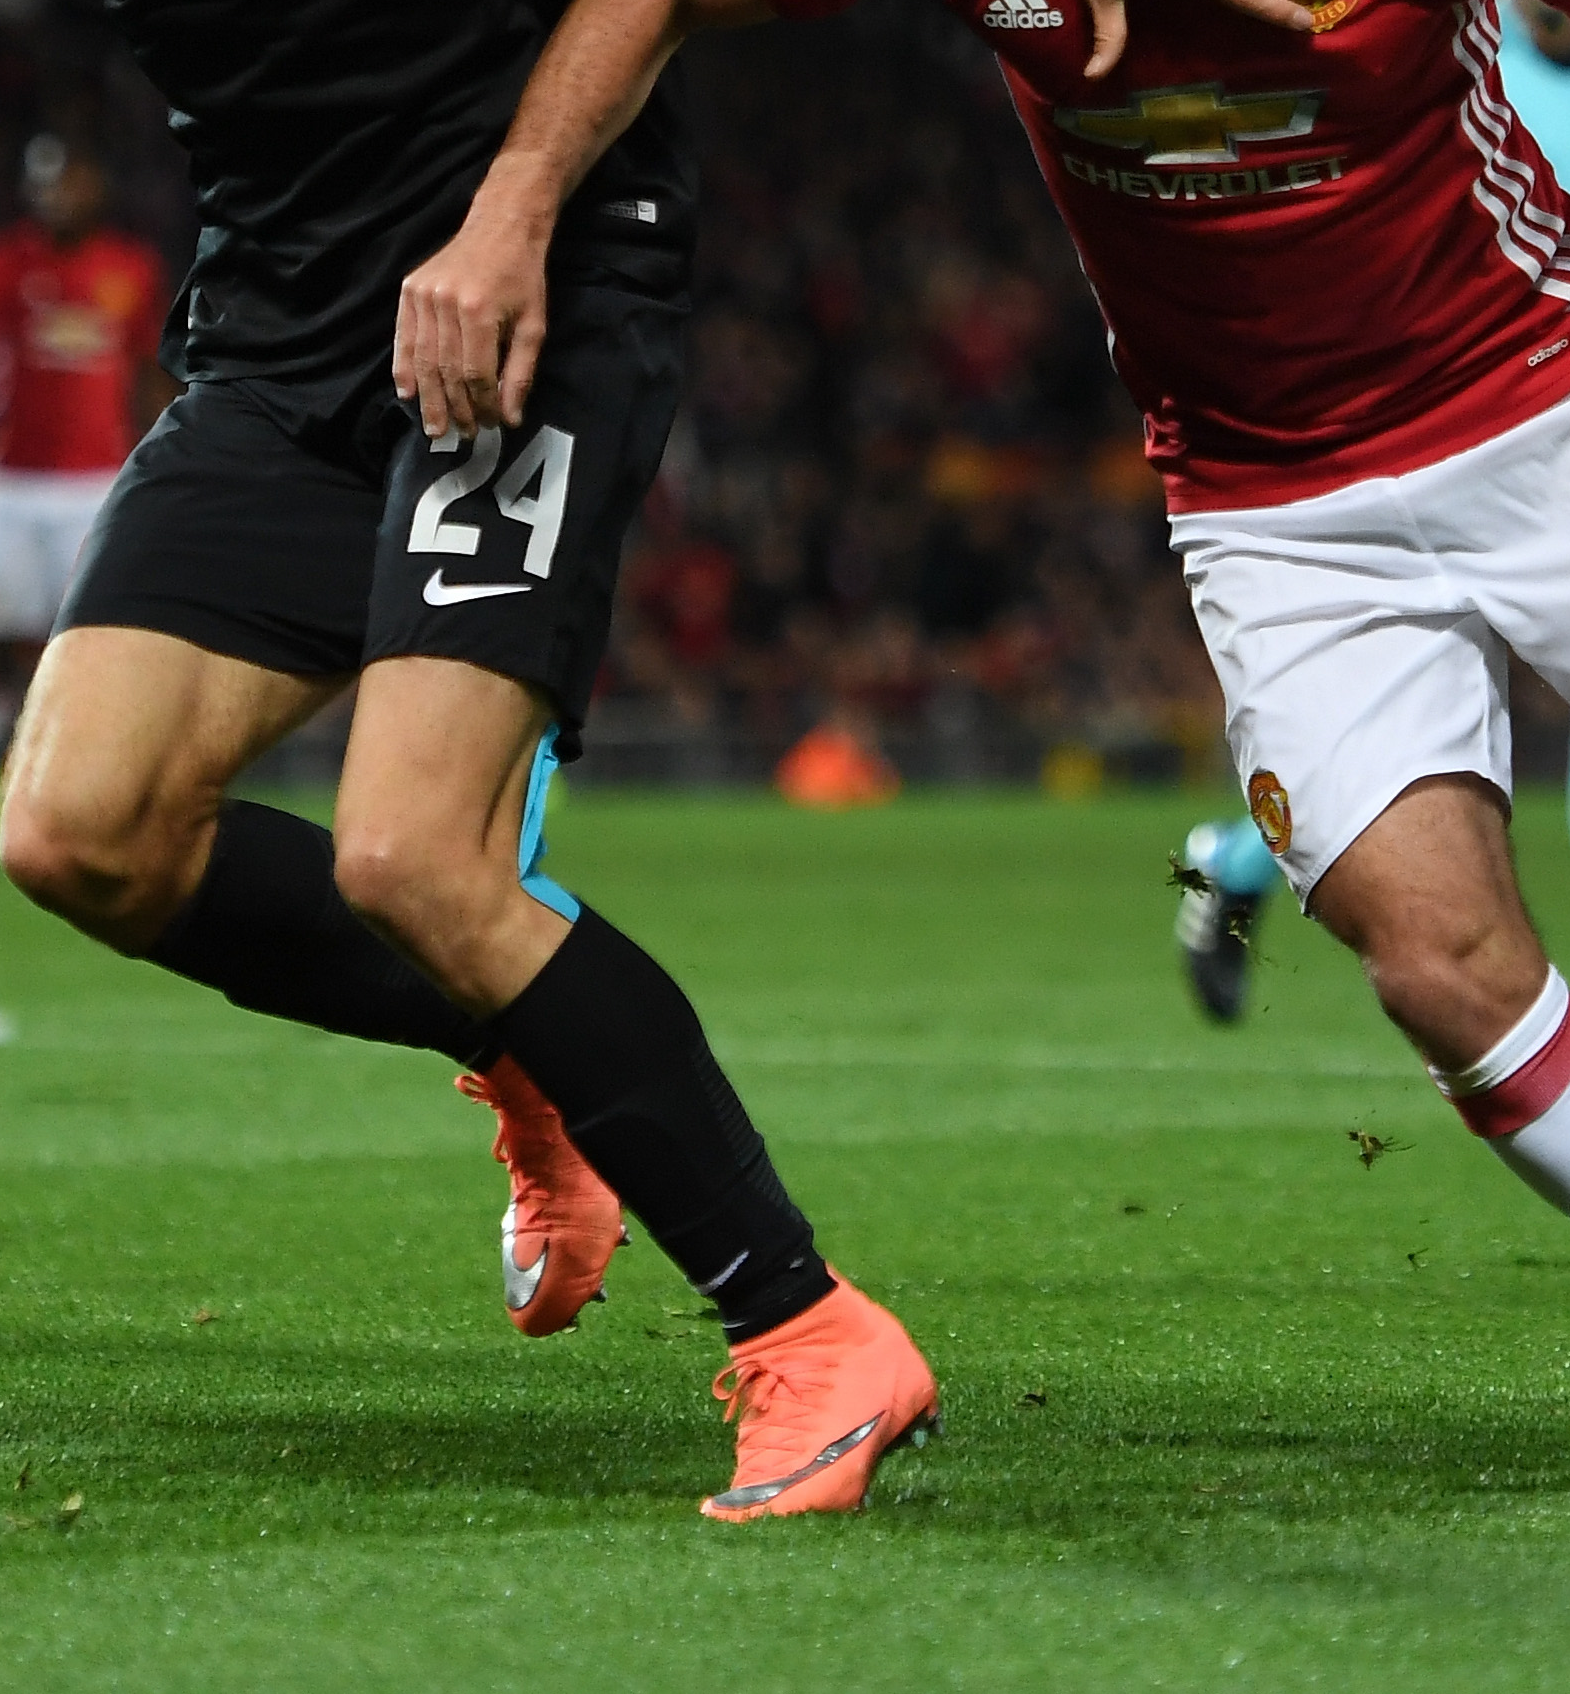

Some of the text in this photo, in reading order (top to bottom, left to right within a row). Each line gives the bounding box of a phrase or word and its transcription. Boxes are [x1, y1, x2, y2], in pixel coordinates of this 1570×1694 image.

[983, 8, 1064, 29] adidas
[1062, 155, 1348, 201] CHEVROLET
[407, 423, 575, 580] 24
